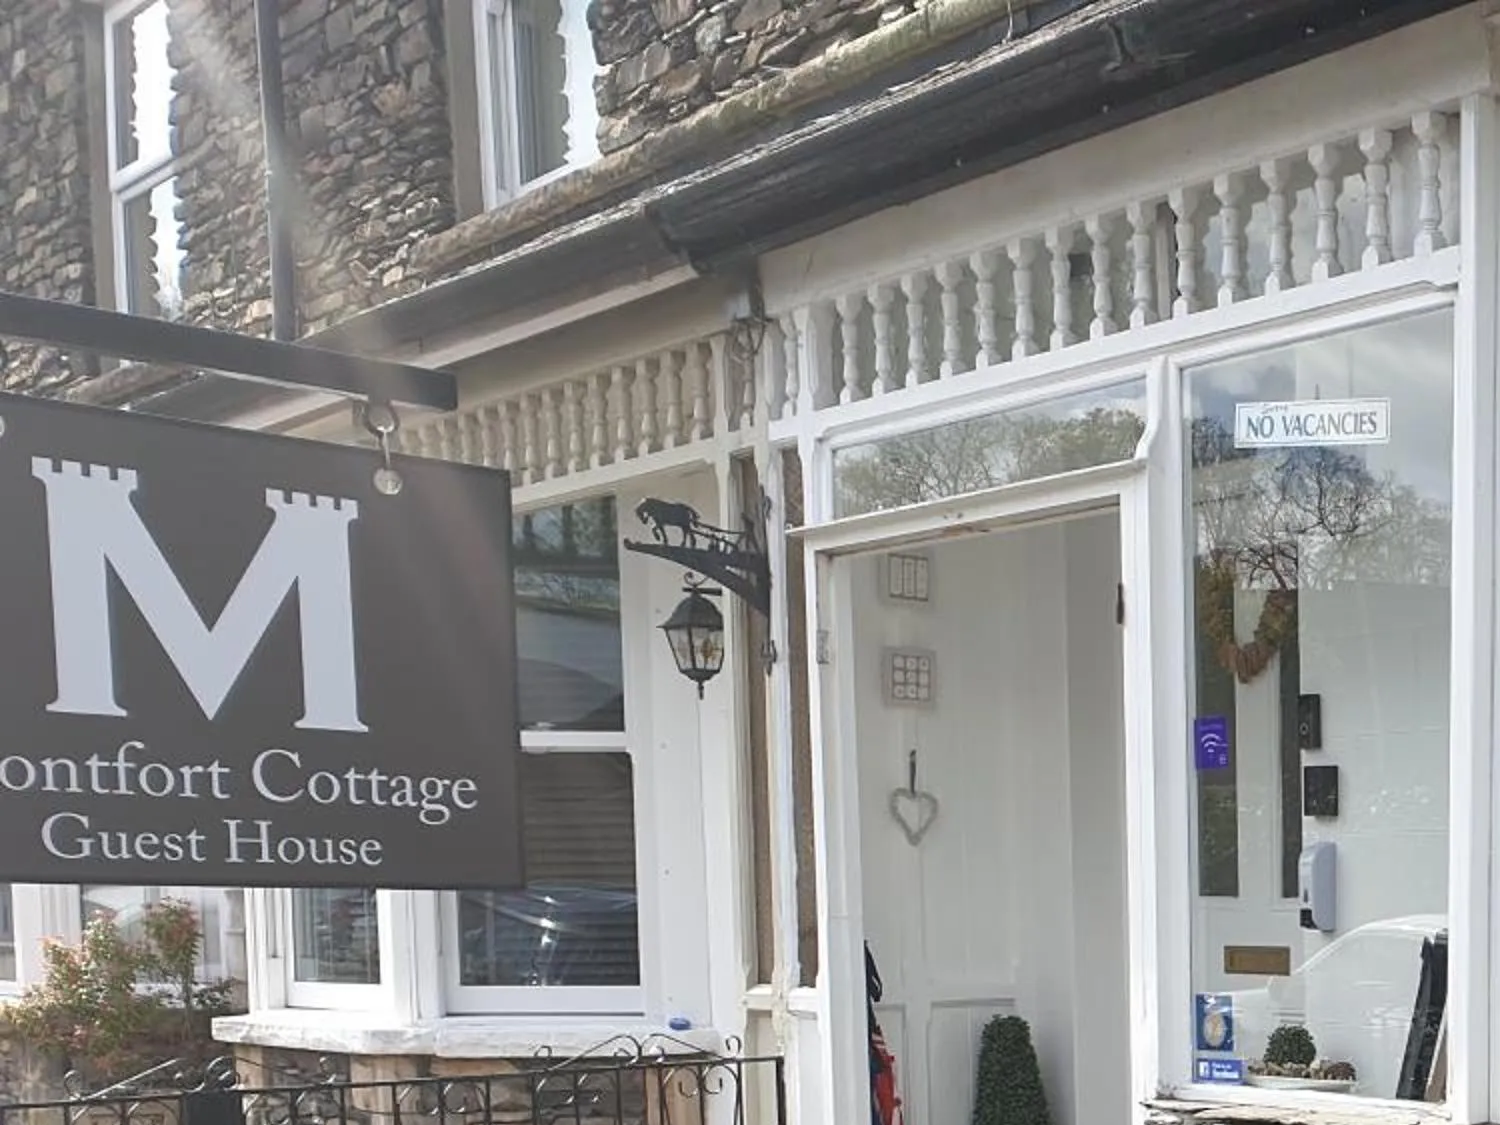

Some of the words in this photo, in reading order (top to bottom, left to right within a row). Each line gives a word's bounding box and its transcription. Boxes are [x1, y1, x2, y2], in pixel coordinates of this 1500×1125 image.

[1246, 415, 1275, 438] NO
[1281, 411, 1378, 437] VACANCIES
[31, 455, 369, 733] M
[0, 740, 232, 799] ontfort
[252, 749, 478, 825] Cottage
[41, 812, 207, 862] Guest
[223, 819, 384, 866] House
